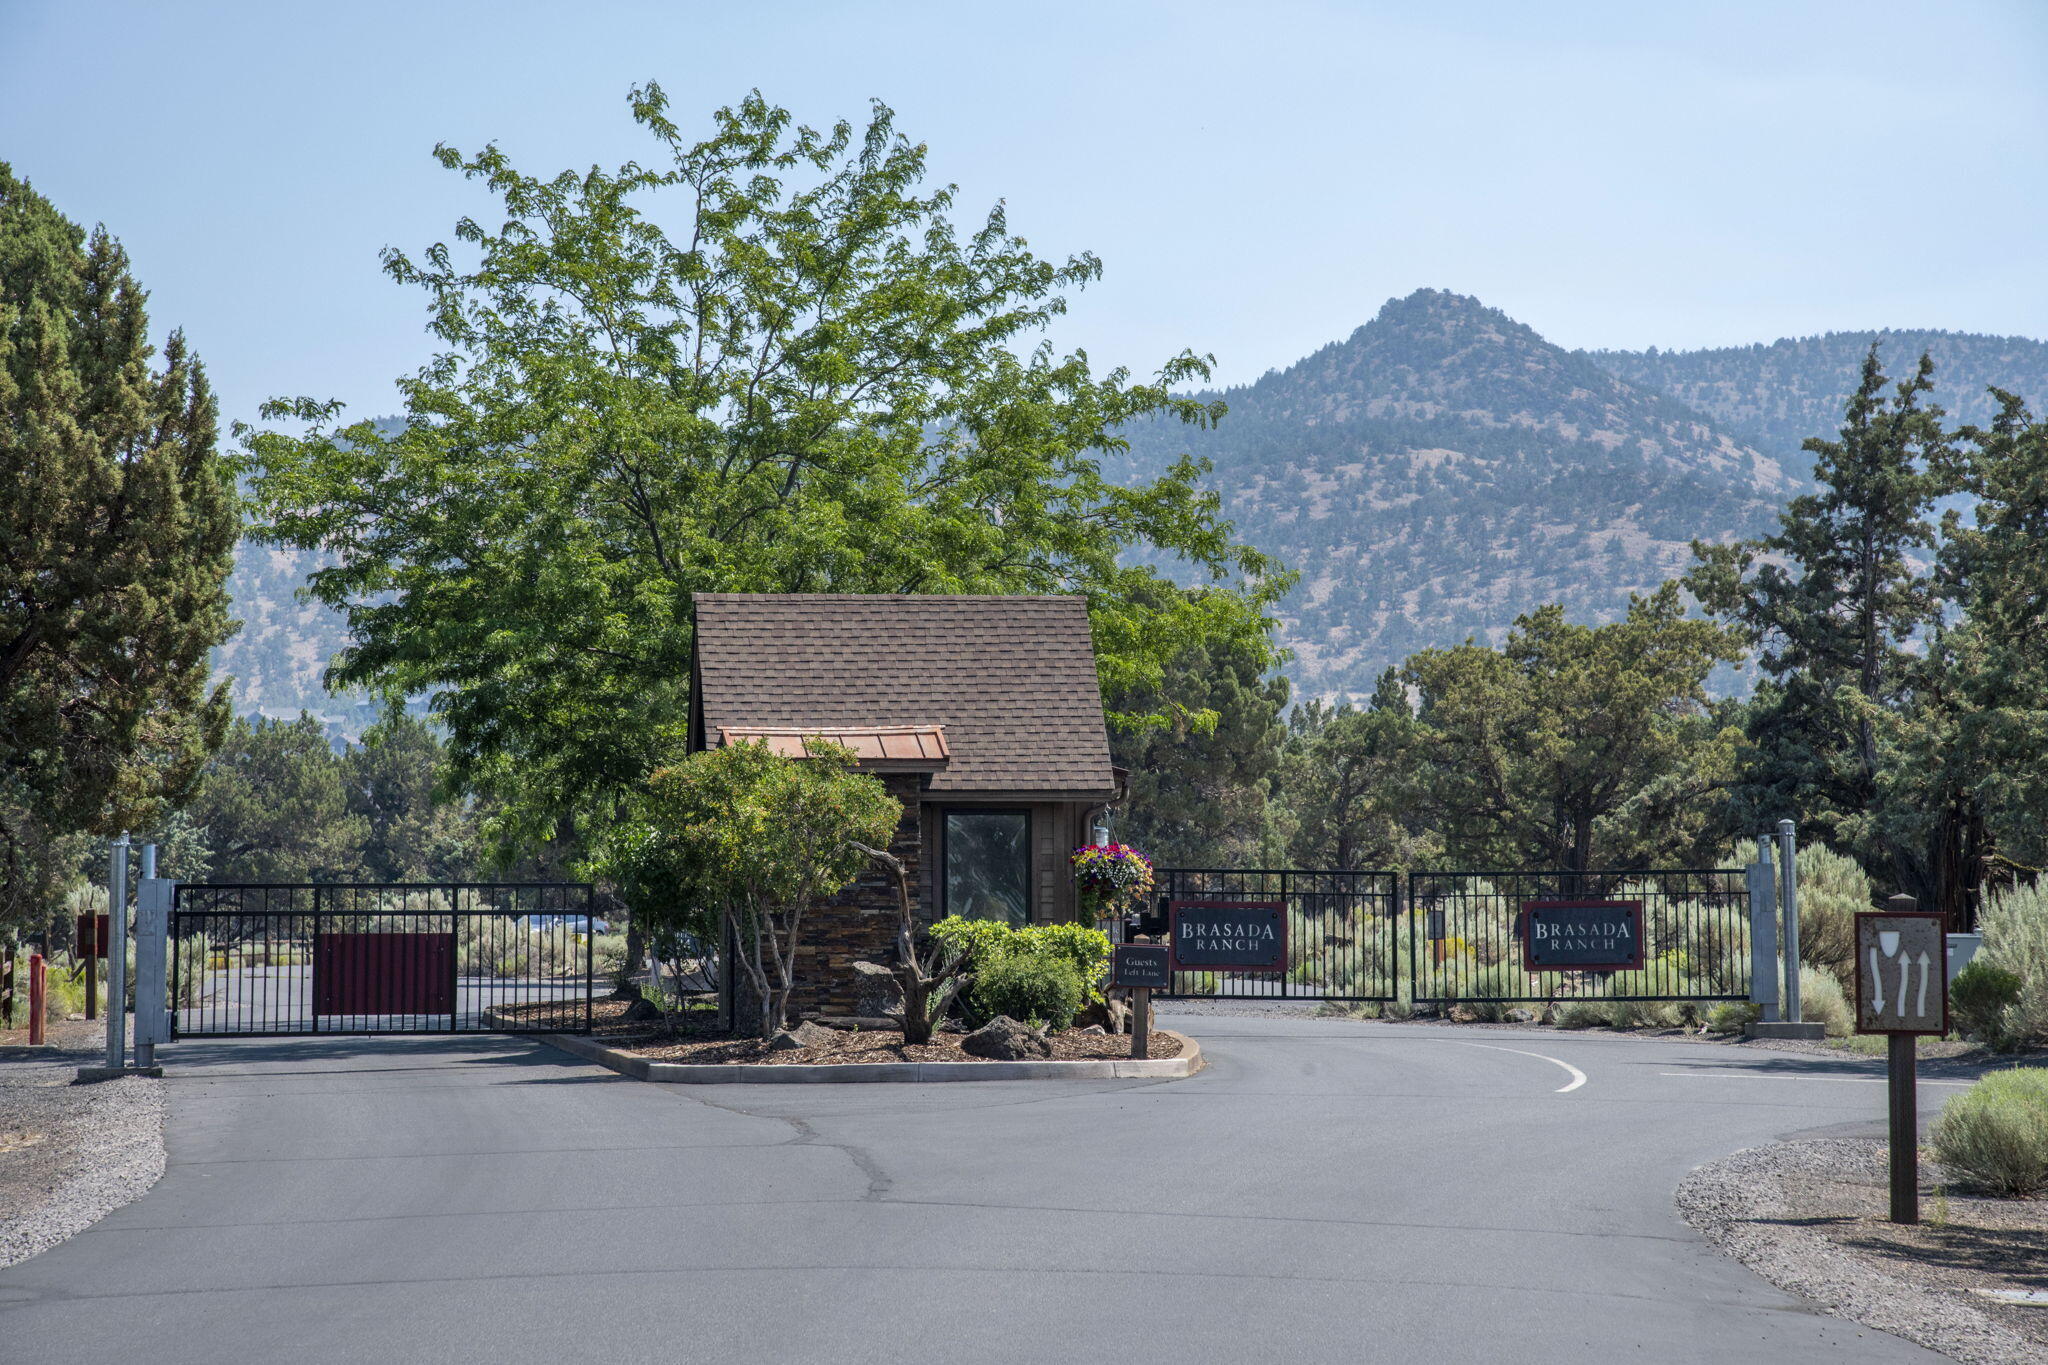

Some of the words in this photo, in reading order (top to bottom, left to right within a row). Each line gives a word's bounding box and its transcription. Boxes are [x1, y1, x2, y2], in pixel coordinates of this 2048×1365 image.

[1182, 923, 1274, 939] BRASADA
[1536, 922, 1630, 939] BRASADA
[1197, 939, 1259, 950] RANCH
[1551, 939, 1614, 950] RANCH
[1126, 957, 1157, 966] Guests
